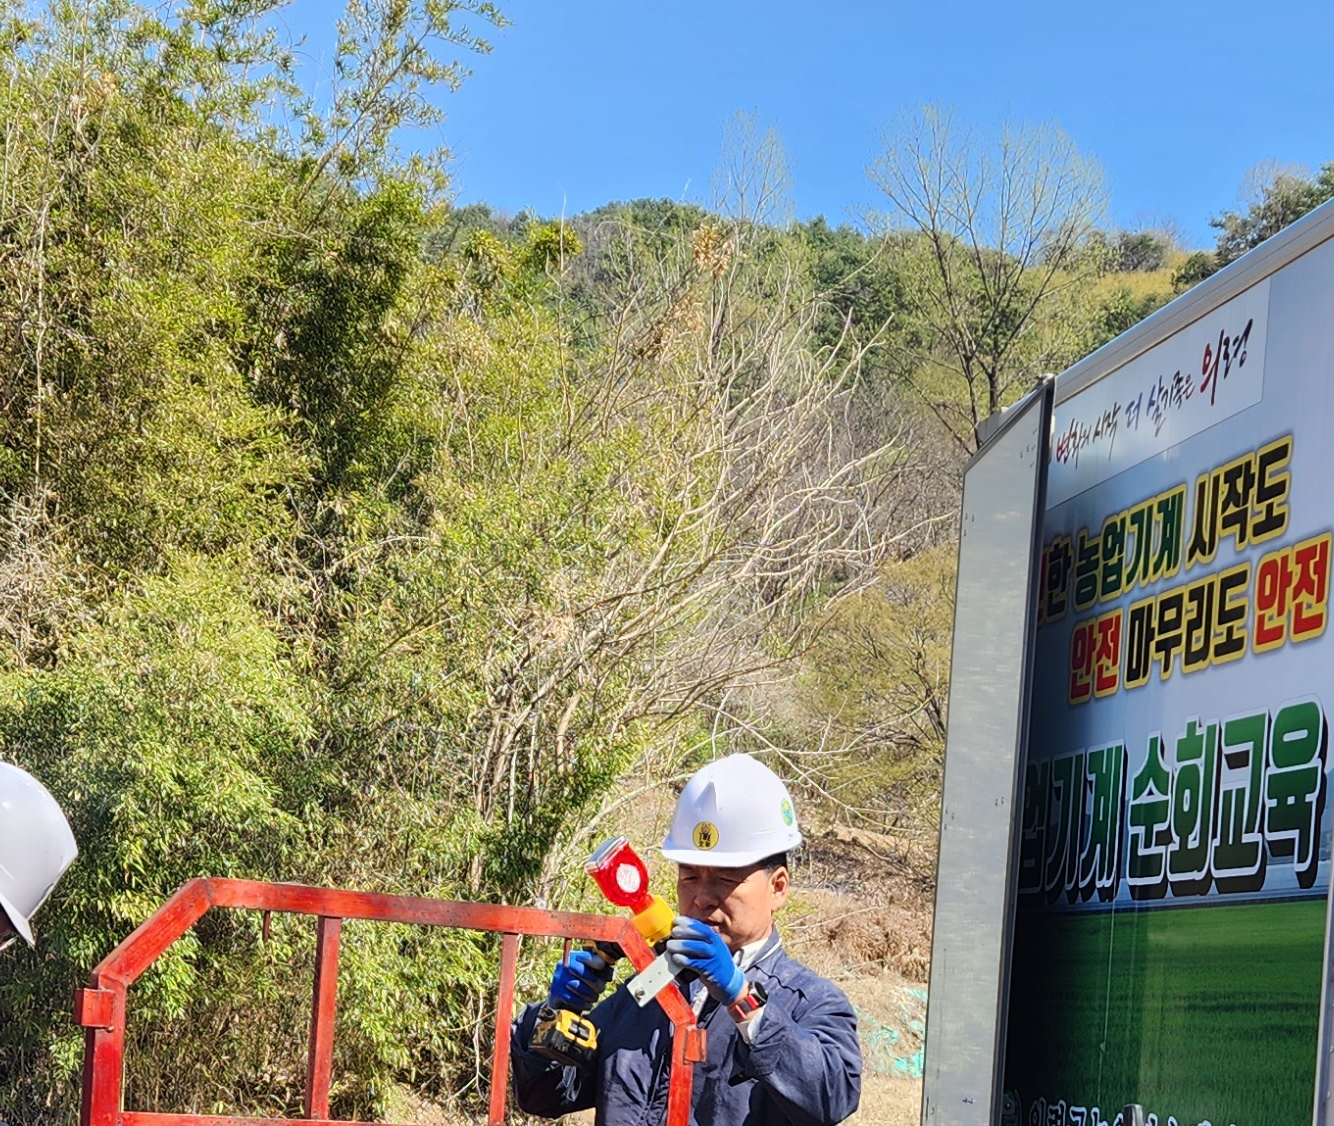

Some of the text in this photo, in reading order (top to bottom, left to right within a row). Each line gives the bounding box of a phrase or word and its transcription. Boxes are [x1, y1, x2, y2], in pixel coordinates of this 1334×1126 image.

[1093, 402, 1122, 461] 시작
[1125, 392, 1143, 430] 더
[1038, 435, 1293, 627] 한 농업기계 시작도
[1069, 533, 1332, 704] 안전 마무리도 안전
[1128, 697, 1325, 894] 순회교육
